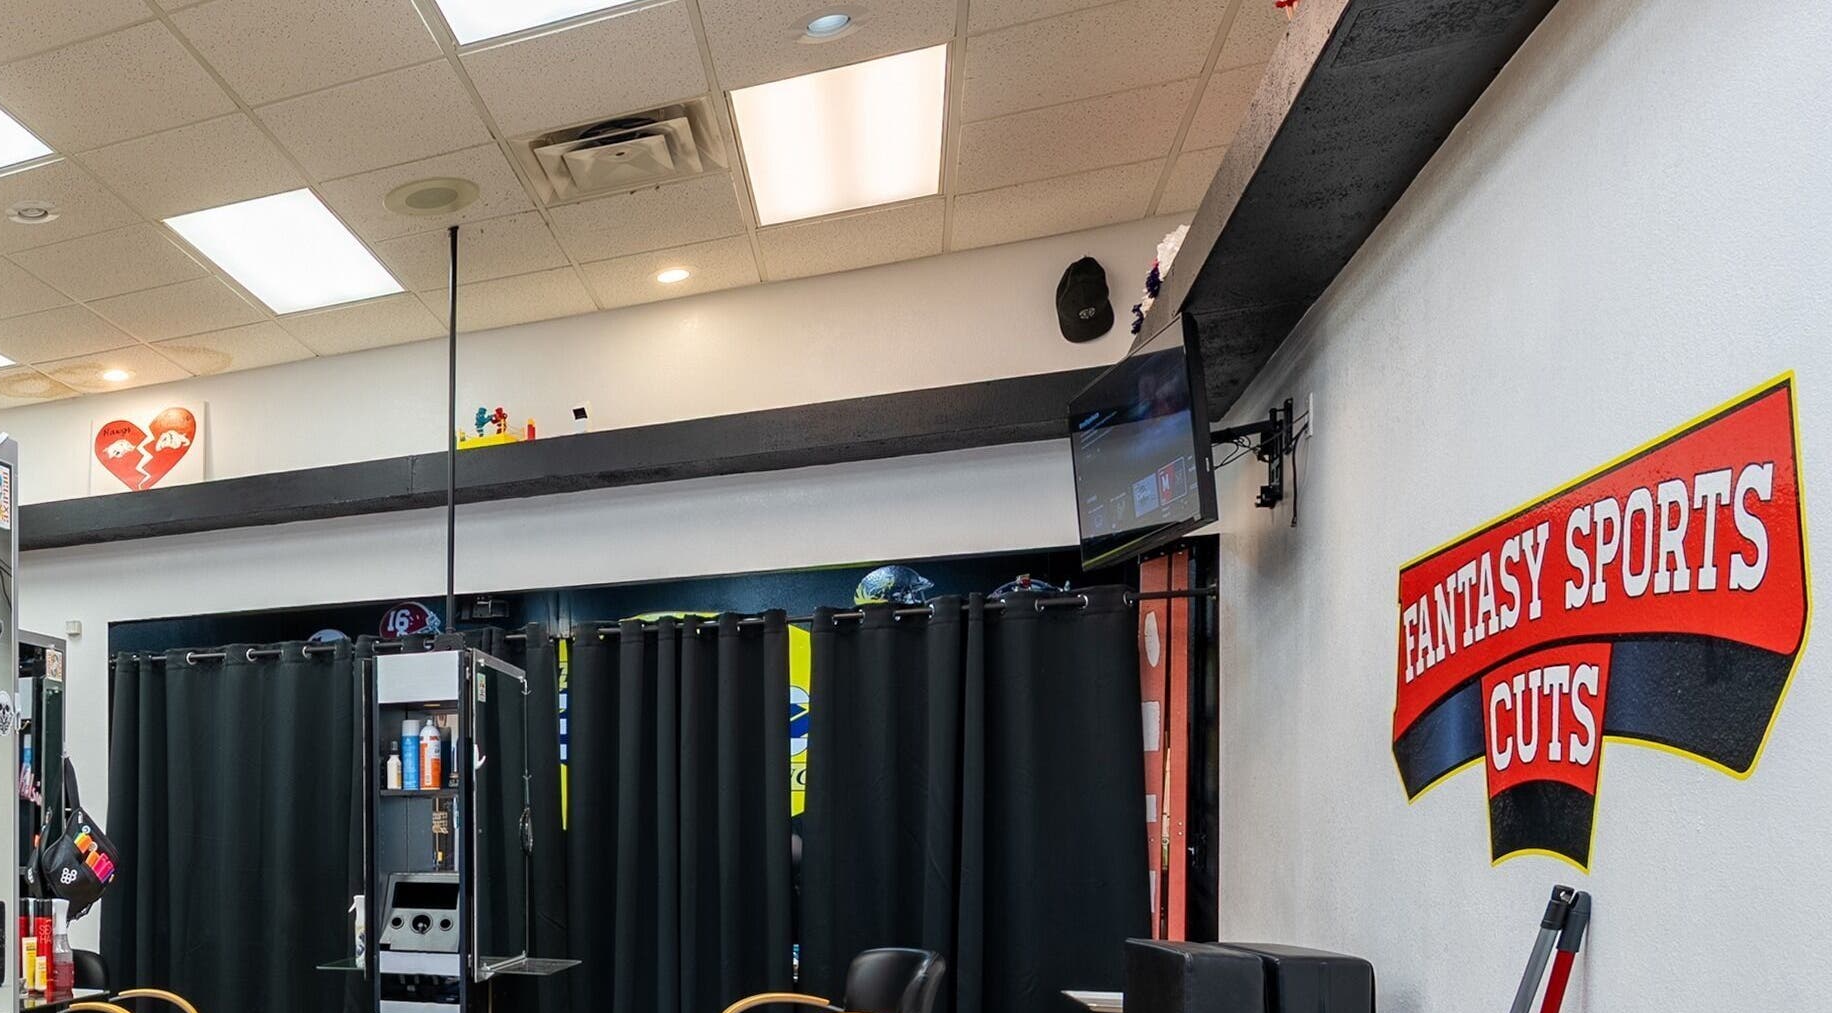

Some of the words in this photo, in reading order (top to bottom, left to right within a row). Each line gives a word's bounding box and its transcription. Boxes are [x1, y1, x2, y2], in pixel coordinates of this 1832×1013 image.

[1403, 521, 1550, 683] FANTASY
[1565, 462, 1774, 609] SPORTS
[1489, 664, 1600, 772] CUTS
